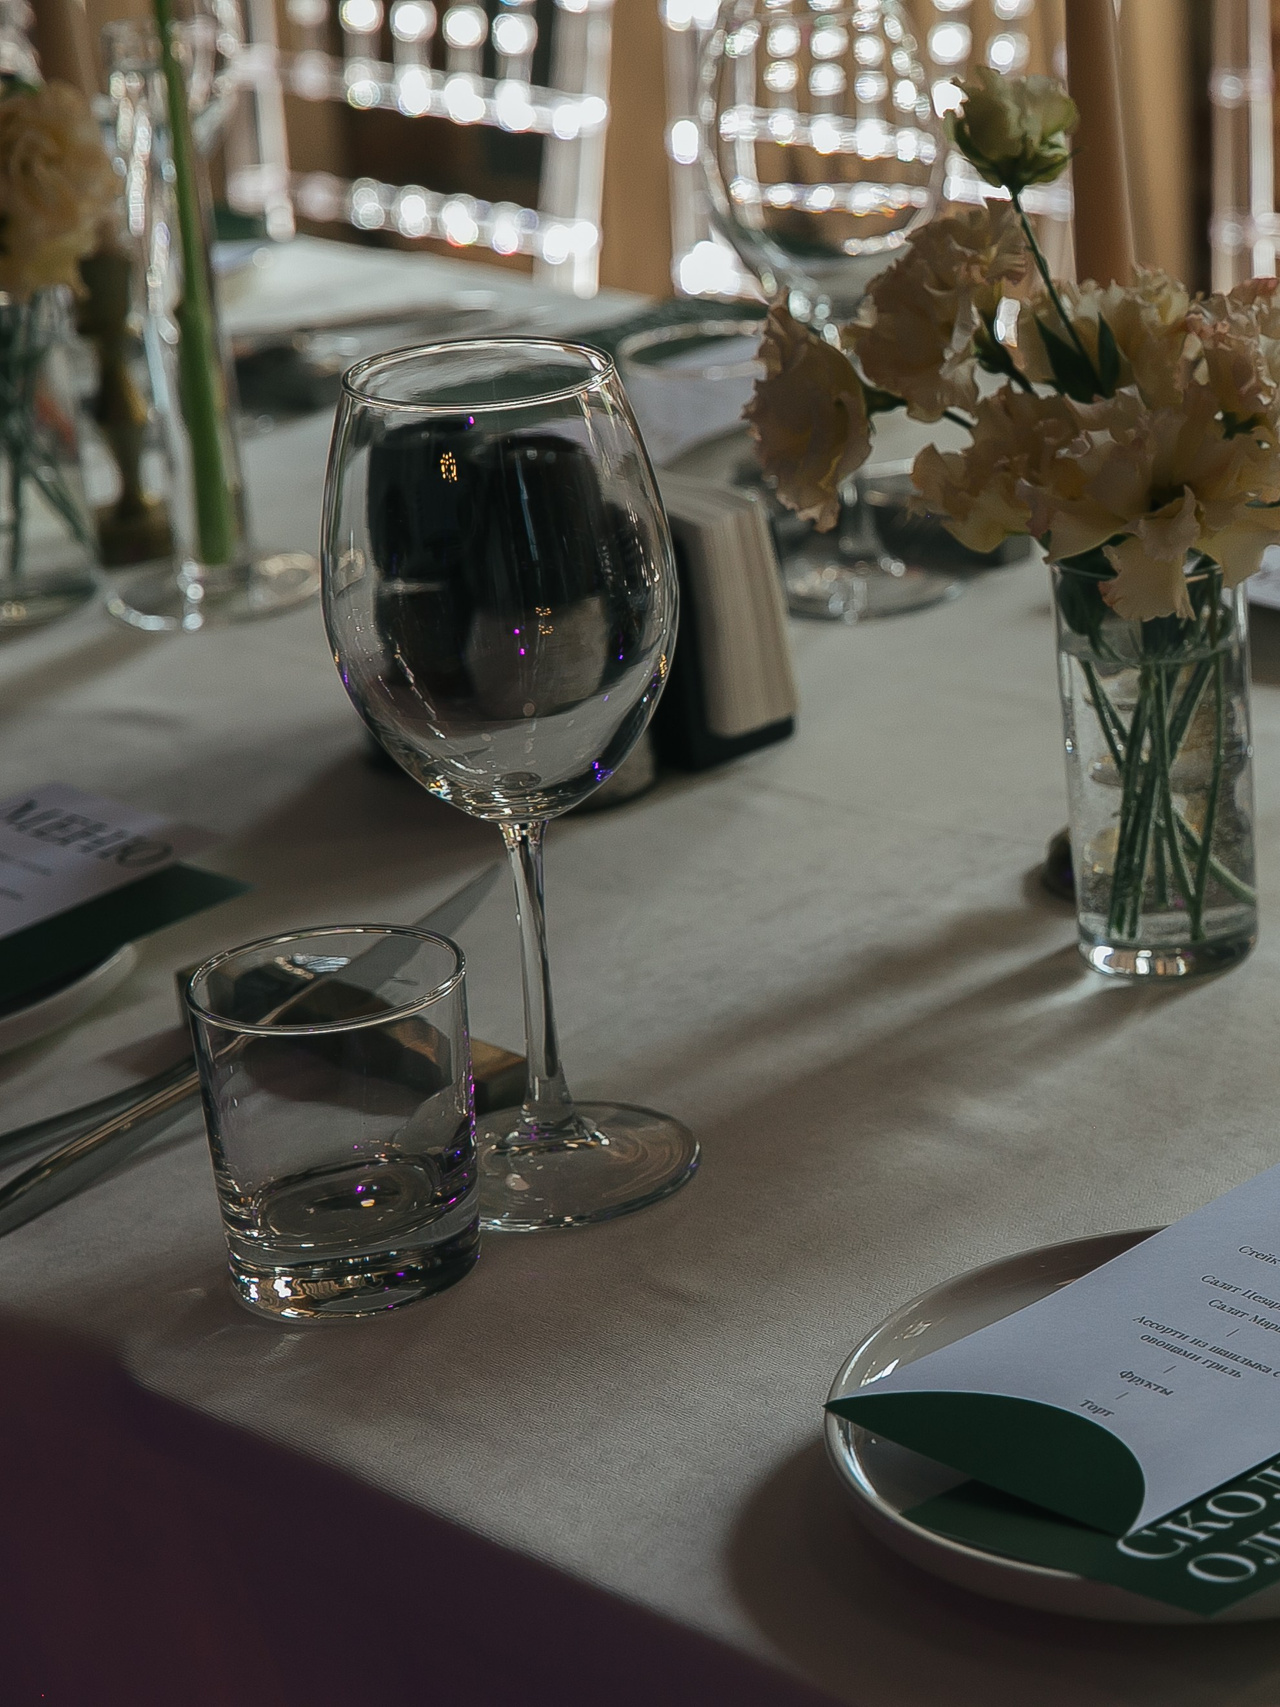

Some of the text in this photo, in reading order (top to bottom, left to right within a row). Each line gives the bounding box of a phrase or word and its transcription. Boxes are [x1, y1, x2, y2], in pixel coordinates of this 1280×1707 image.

[1238, 1245, 1280, 1266] Стейк
[1201, 1274, 1242, 1294] Салат
[1208, 1299, 1249, 1319] Салат
[1132, 1315, 1190, 1341] Ассорти
[1188, 1335, 1210, 1348] из
[1208, 1344, 1274, 1375] шашлыка
[1201, 1358, 1242, 1379] гриль
[1119, 1369, 1174, 1398] Фрукты
[1079, 1399, 1114, 1418] Торт
